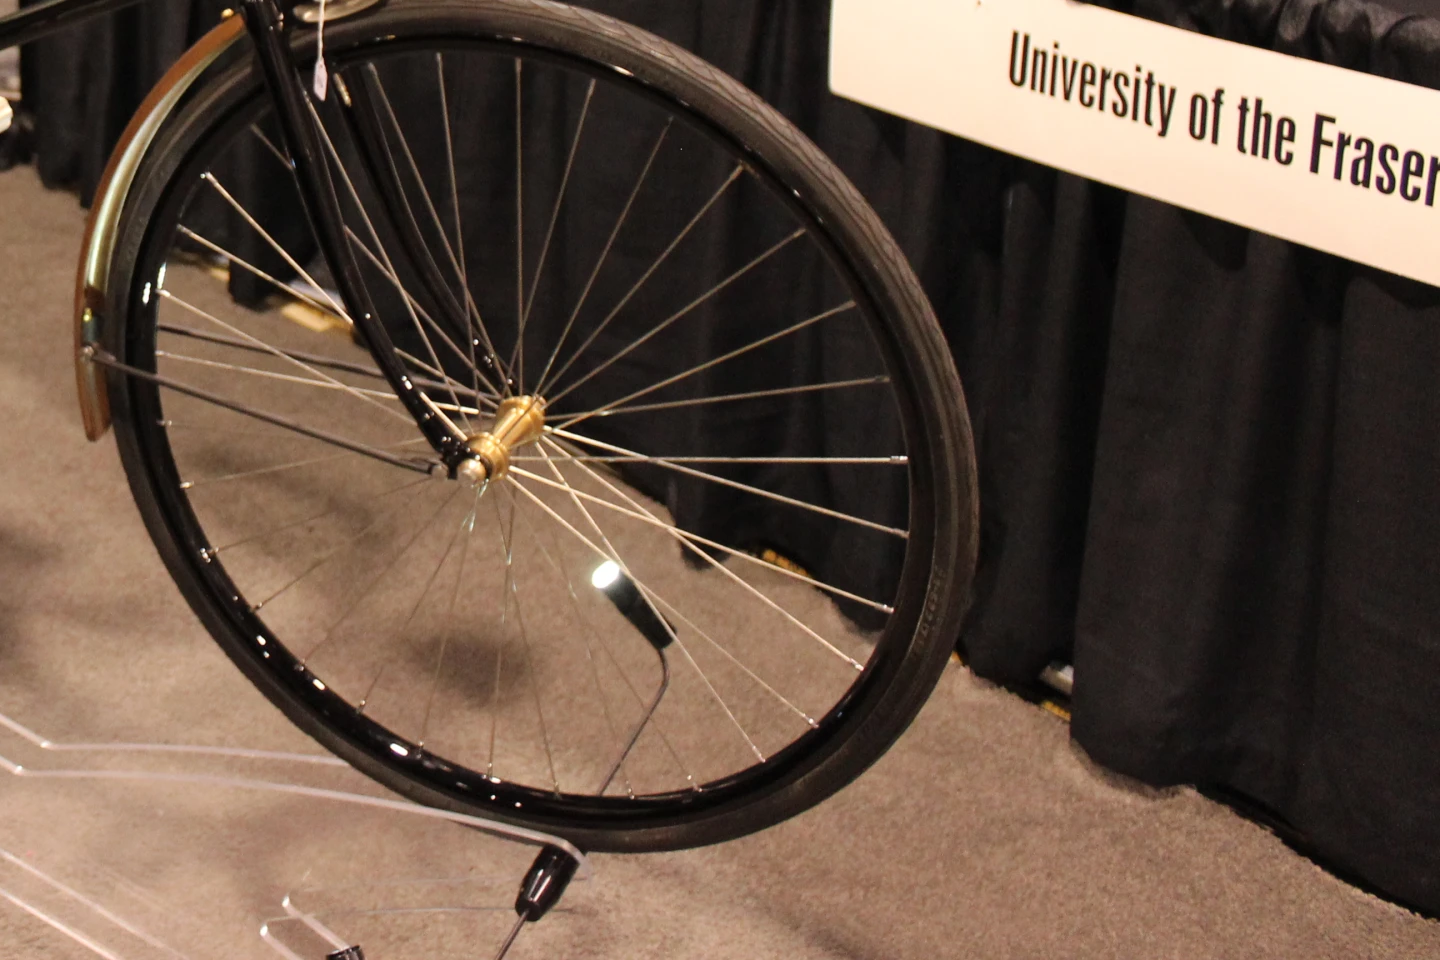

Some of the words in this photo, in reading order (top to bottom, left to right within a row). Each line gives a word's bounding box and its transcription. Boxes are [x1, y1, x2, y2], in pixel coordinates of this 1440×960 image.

[1009, 31, 1177, 138] University
[1188, 88, 1225, 145] of
[1237, 97, 1296, 166] the
[1309, 113, 1440, 207] Fraser
